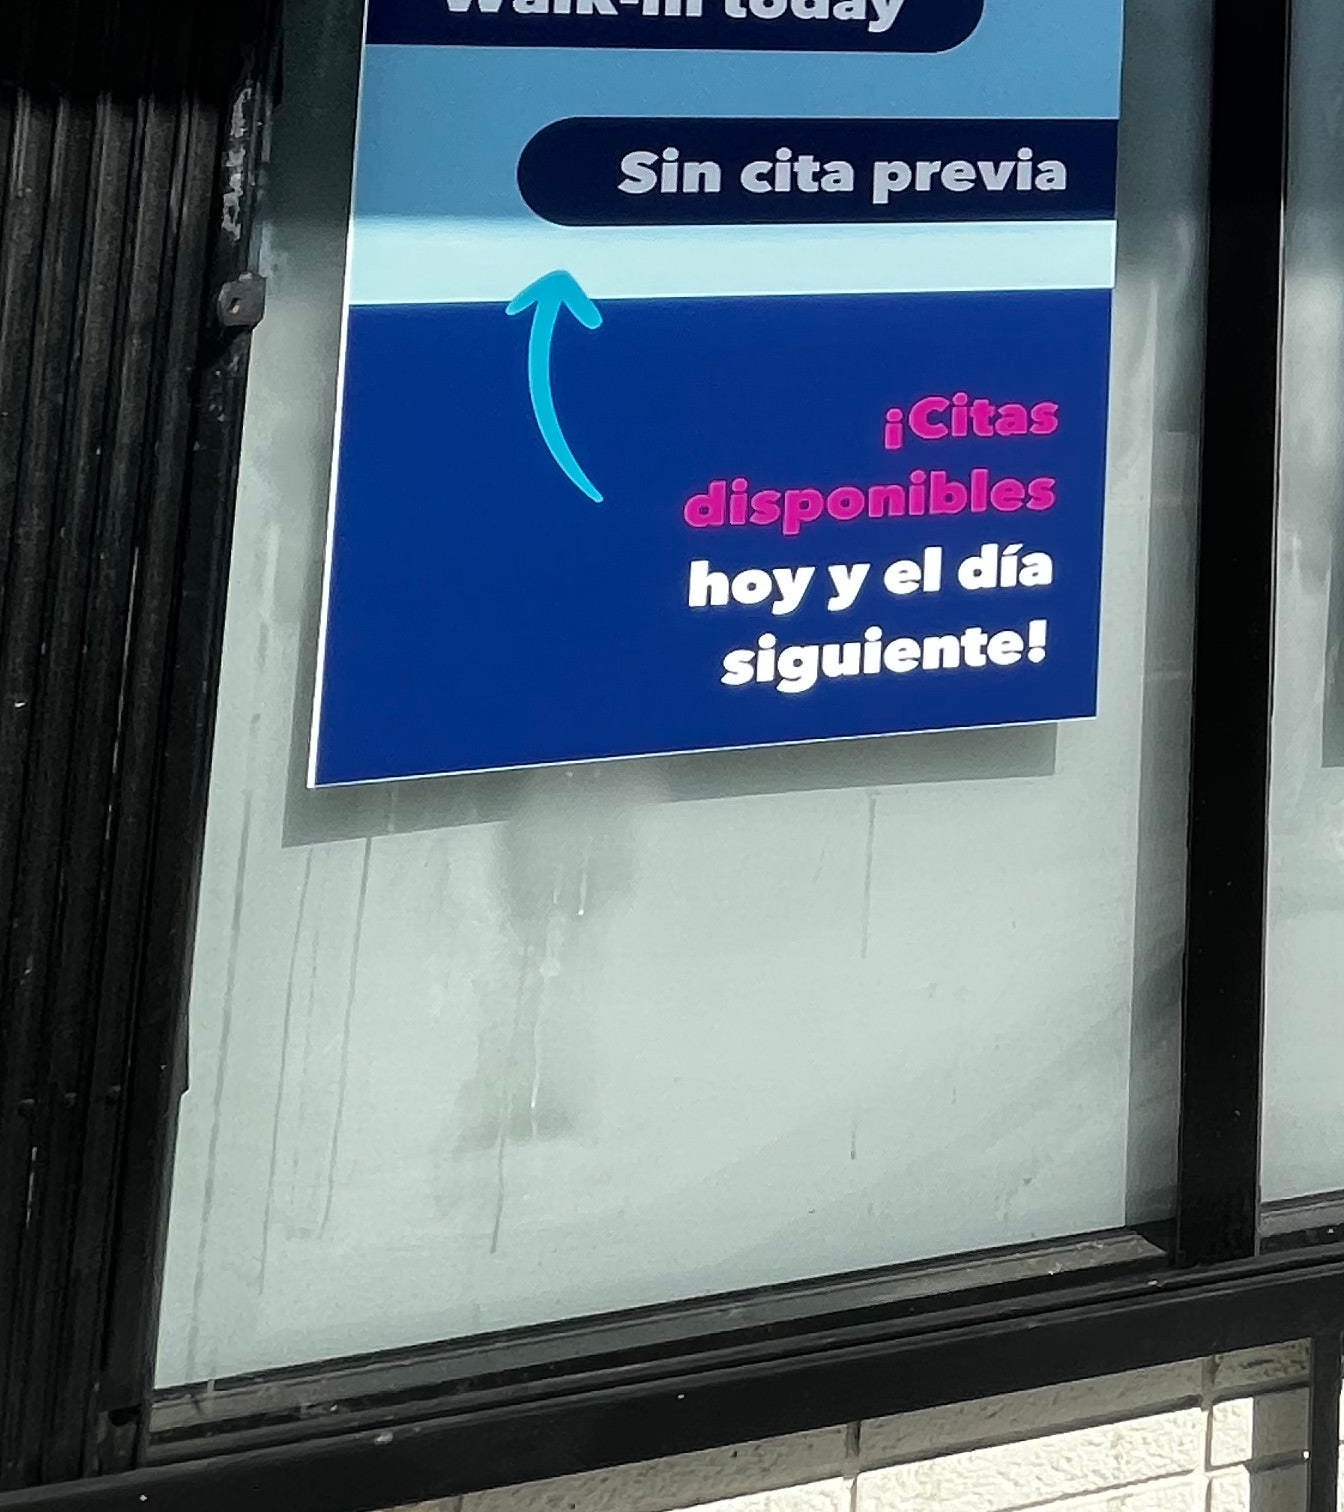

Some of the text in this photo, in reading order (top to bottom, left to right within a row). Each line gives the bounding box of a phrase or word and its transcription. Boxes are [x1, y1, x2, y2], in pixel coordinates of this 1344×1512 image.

[618, 147, 1067, 204] Sin cita previa
[884, 392, 1059, 450] ¡Citas
[683, 471, 1057, 535] disponibles
[689, 544, 1053, 615] hoy y el día
[720, 619, 1047, 693] siguiente!
